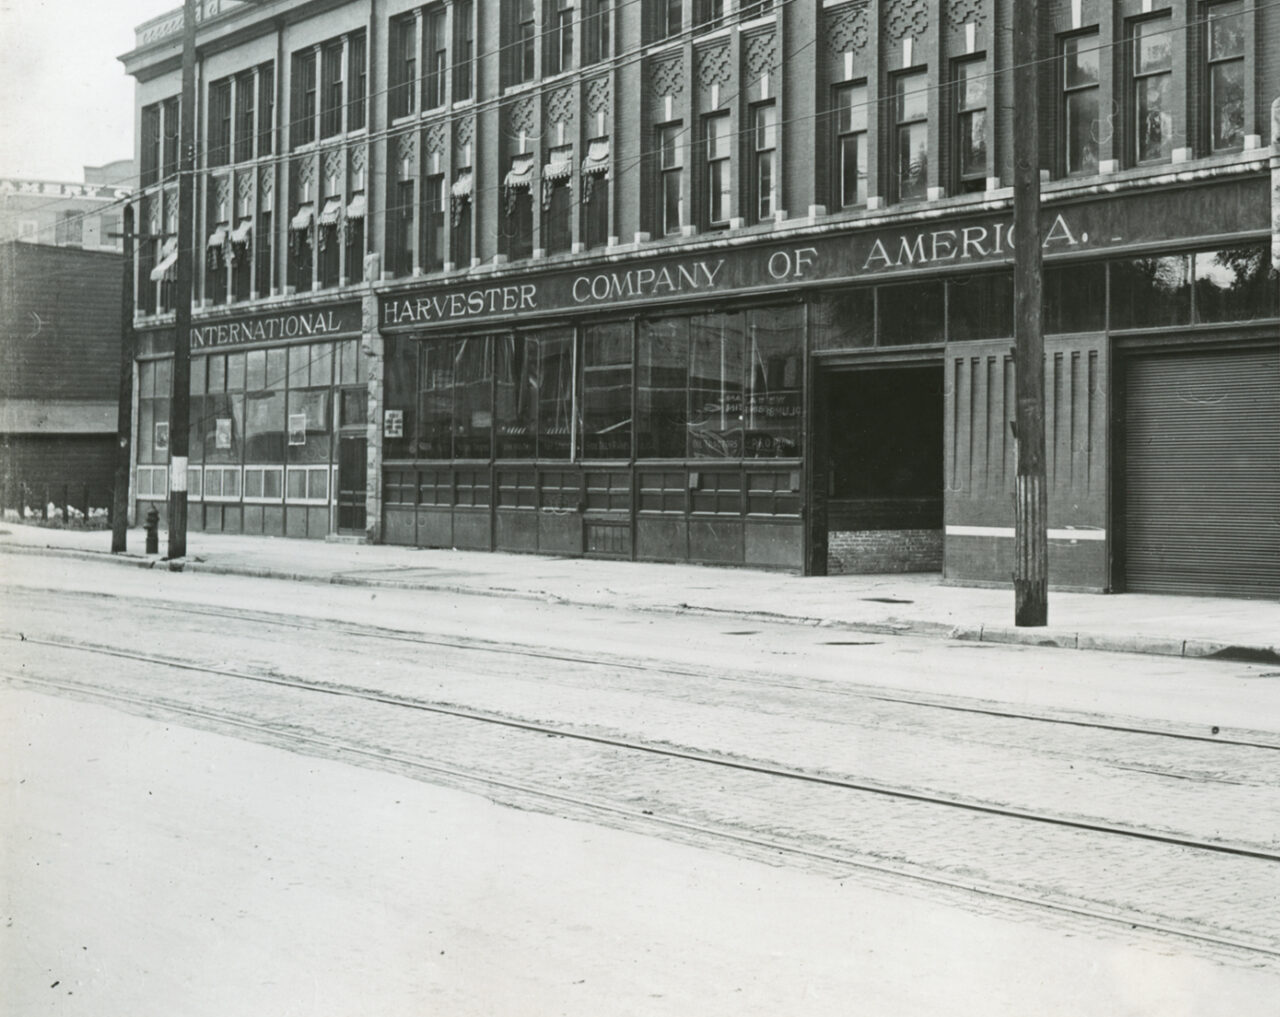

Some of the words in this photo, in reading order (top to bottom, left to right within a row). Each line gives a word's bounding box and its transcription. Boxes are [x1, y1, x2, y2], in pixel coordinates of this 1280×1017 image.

[189, 310, 342, 349] INTERNATIONAL
[383, 283, 537, 325] HARVESTER
[572, 258, 725, 304] COMPANY
[767, 245, 818, 280] OF
